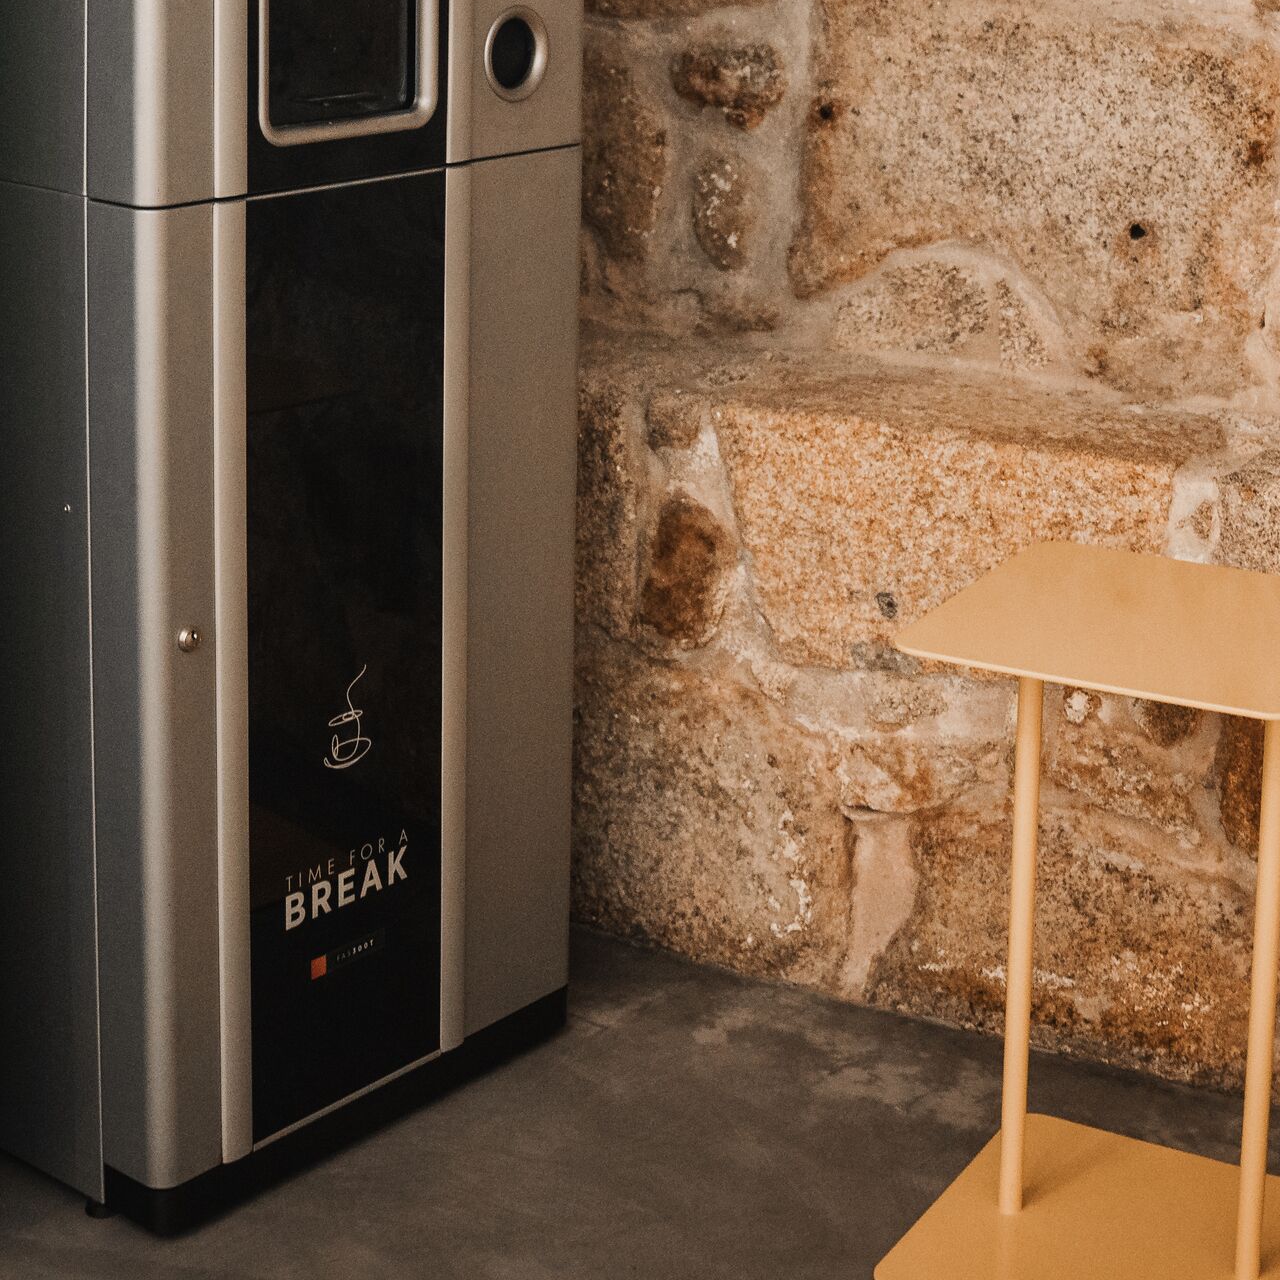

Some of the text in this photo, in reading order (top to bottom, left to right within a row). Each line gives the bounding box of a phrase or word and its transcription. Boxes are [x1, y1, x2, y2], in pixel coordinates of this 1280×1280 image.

[284, 845, 408, 932] BREAK
[285, 828, 409, 893] TIME FOR A
